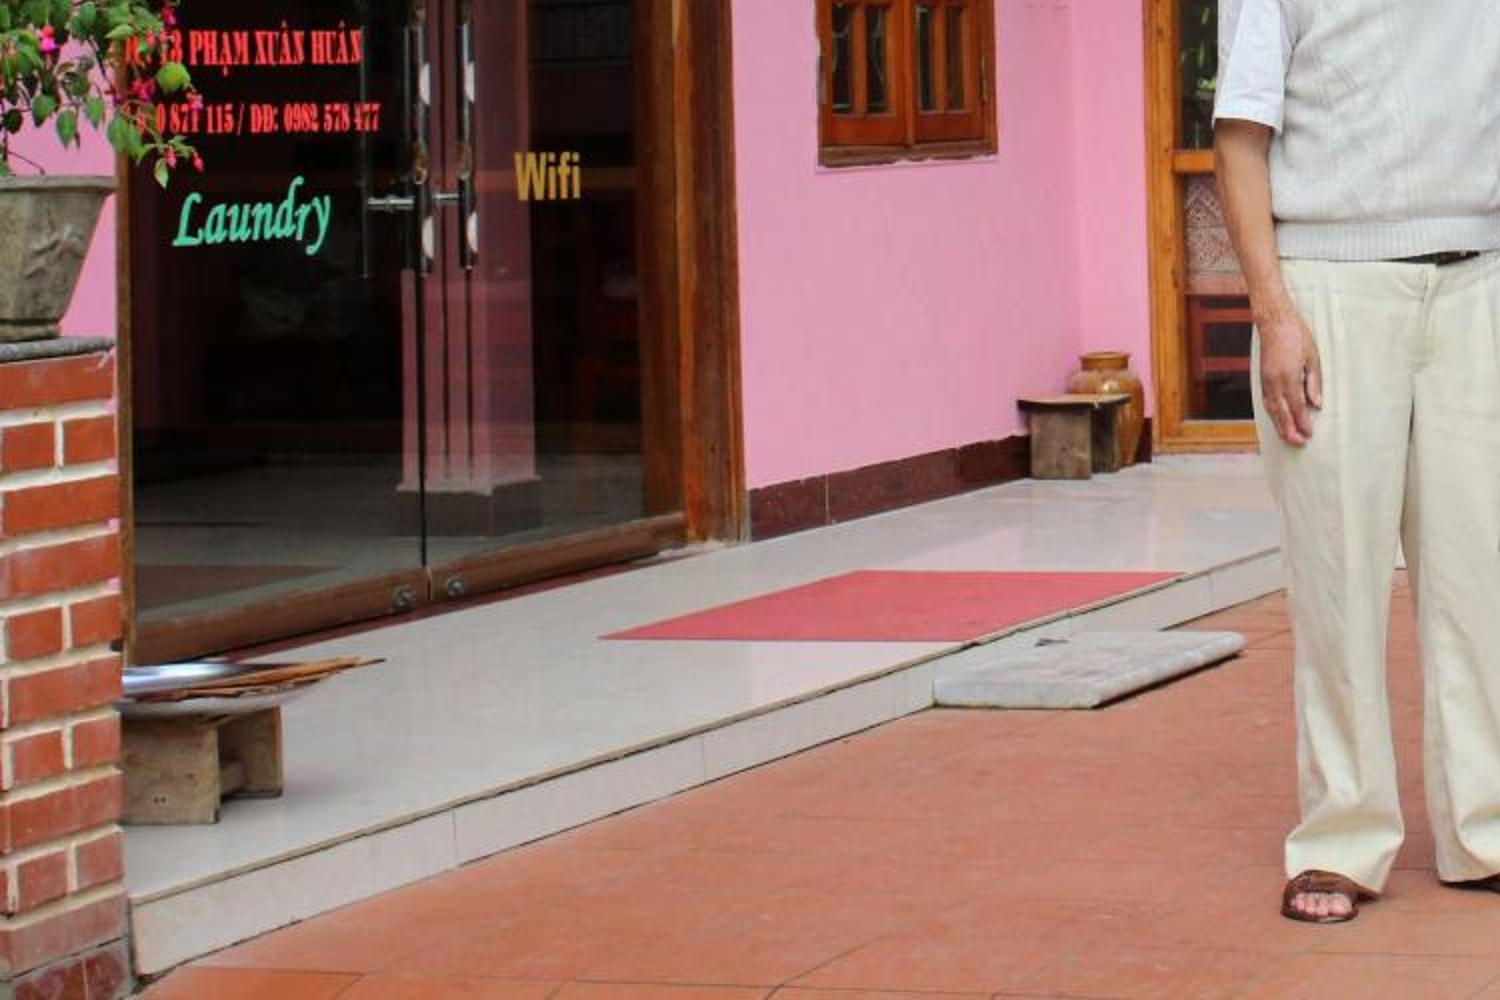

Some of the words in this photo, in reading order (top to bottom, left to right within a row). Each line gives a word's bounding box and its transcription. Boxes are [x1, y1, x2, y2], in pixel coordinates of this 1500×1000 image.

[189, 29, 249, 77] PHẠM
[514, 151, 581, 200] Wifi
[172, 175, 331, 256] Laundry
